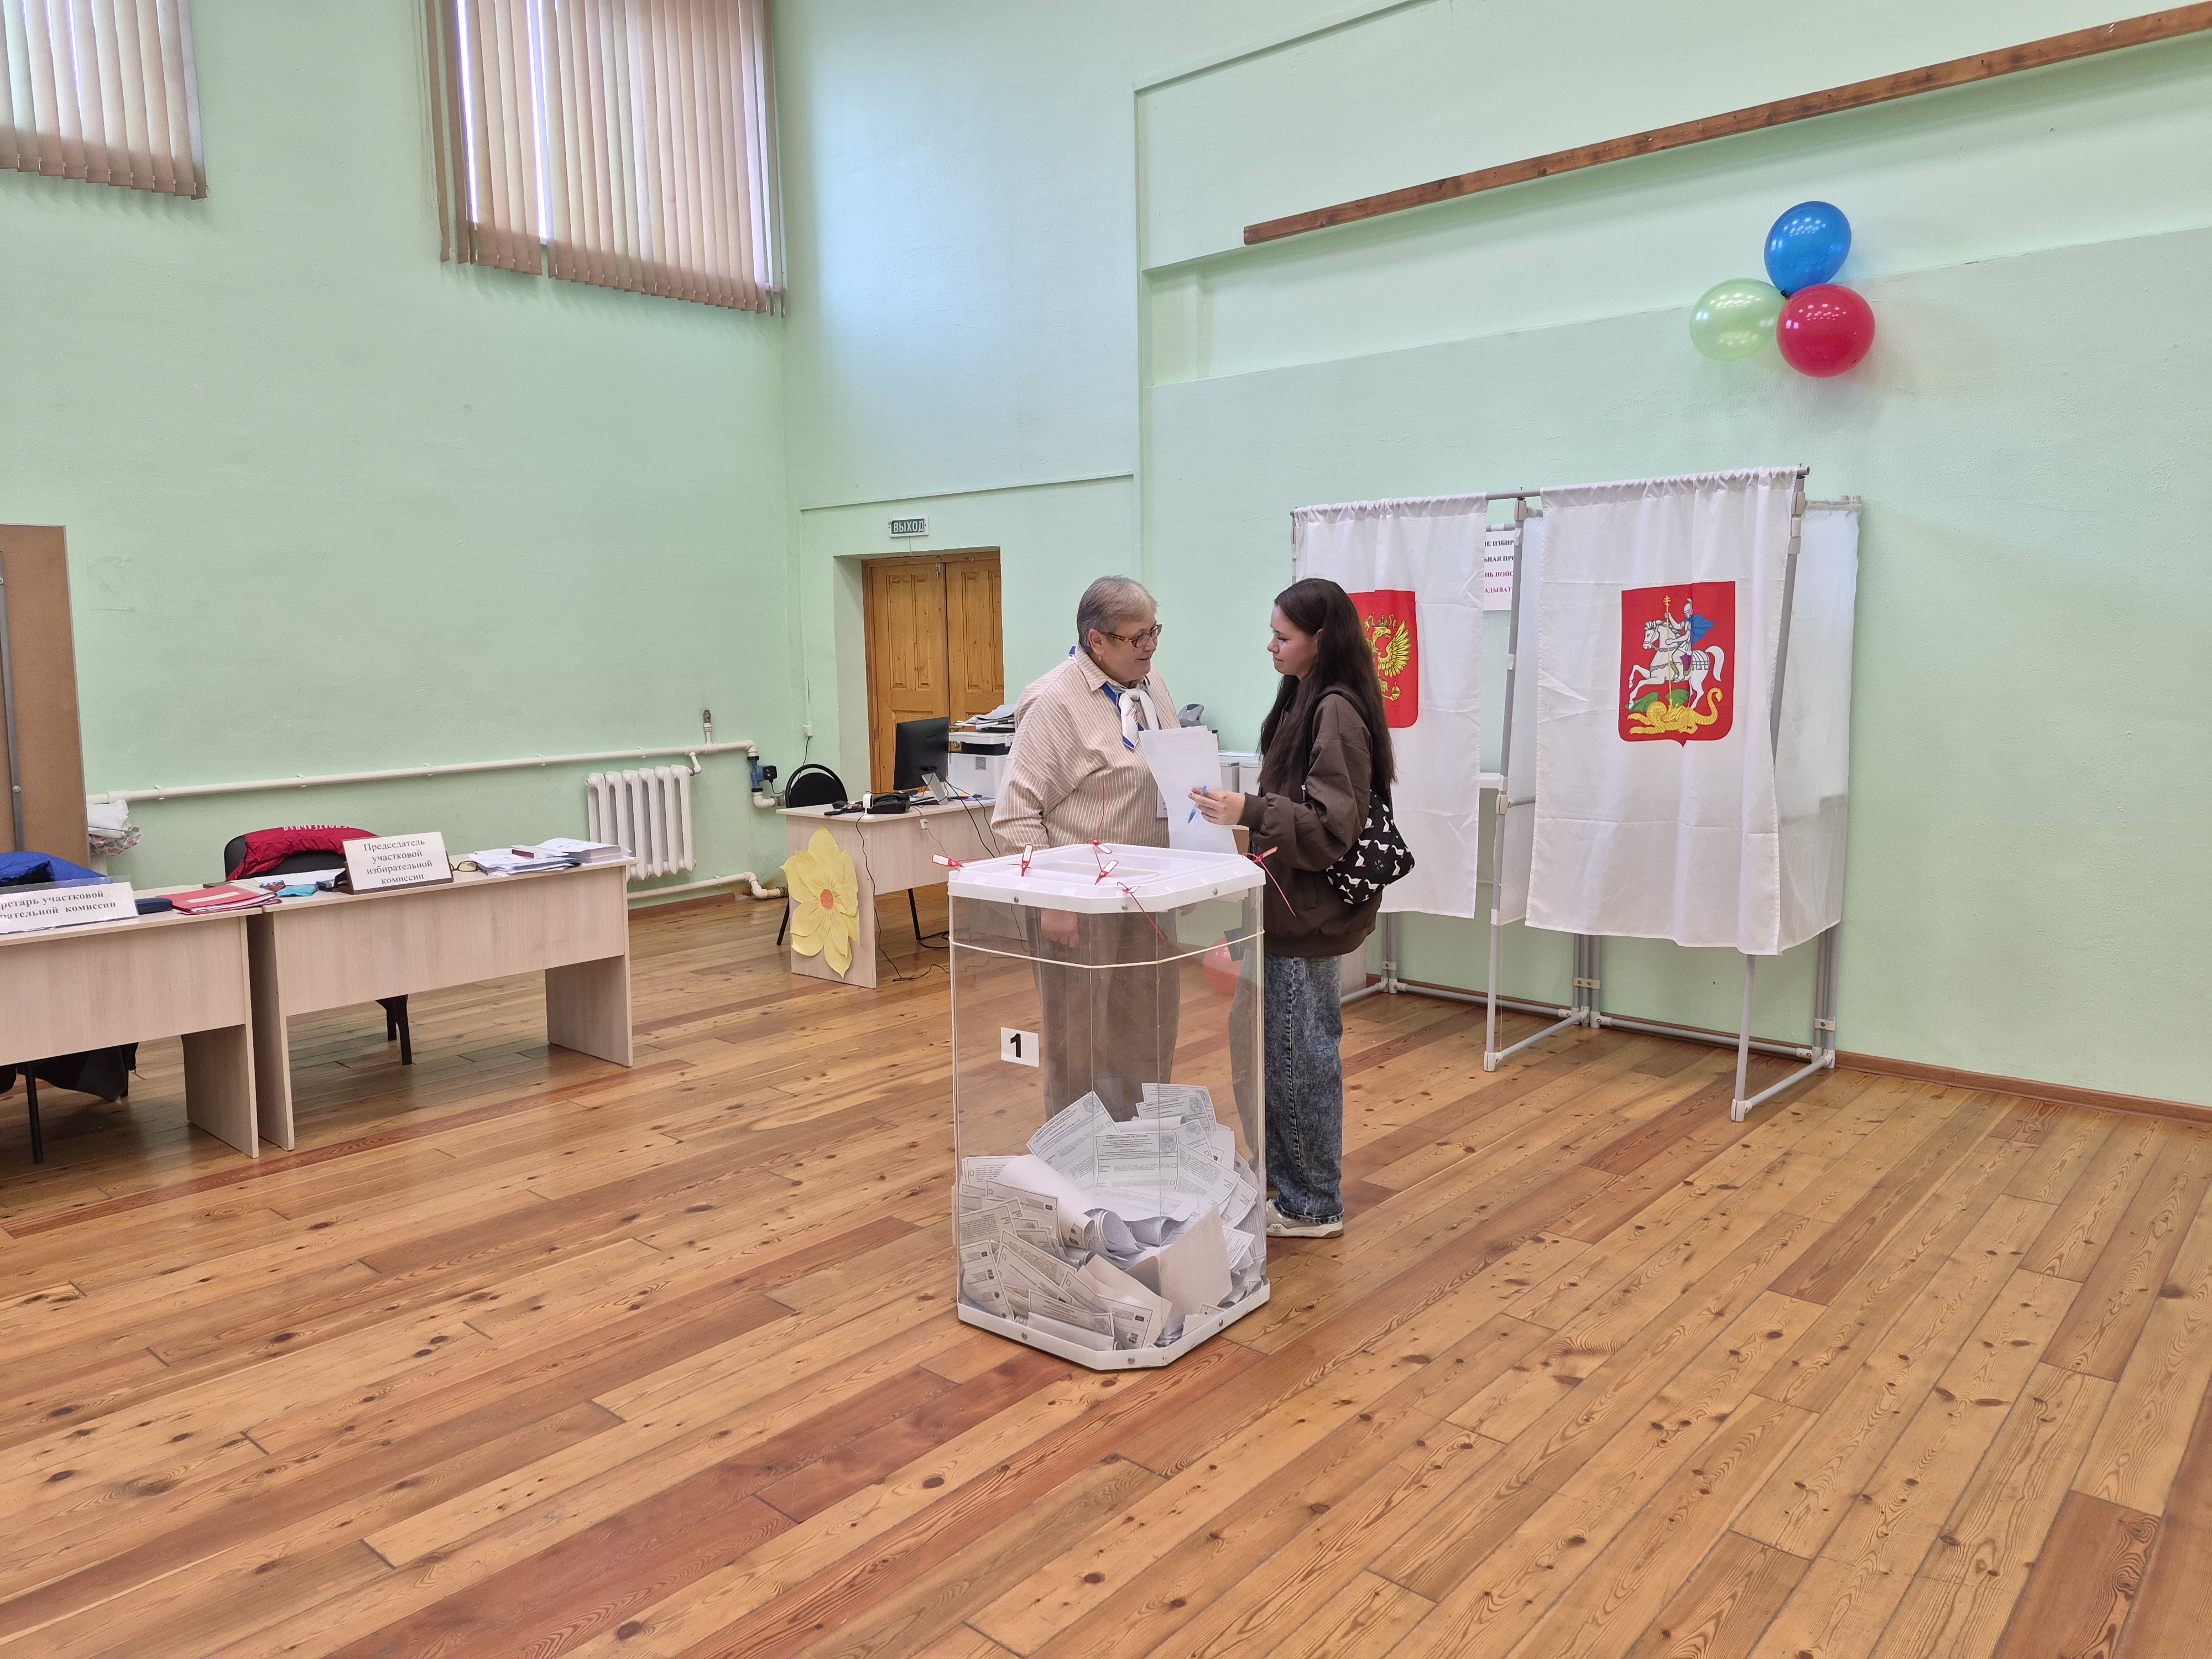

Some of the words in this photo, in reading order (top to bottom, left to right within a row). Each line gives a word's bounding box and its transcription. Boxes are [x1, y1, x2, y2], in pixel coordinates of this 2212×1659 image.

[893, 520, 924, 533] ВЫХОД
[363, 839, 425, 852] Председатель
[372, 849, 422, 864] участковой
[367, 860, 432, 874] избирательной
[381, 874, 424, 884] комиссии
[1, 898, 39, 910] ретарь
[42, 890, 104, 905] участковой
[65, 901, 116, 912] комиссии
[1010, 1033, 1021, 1058] 1
